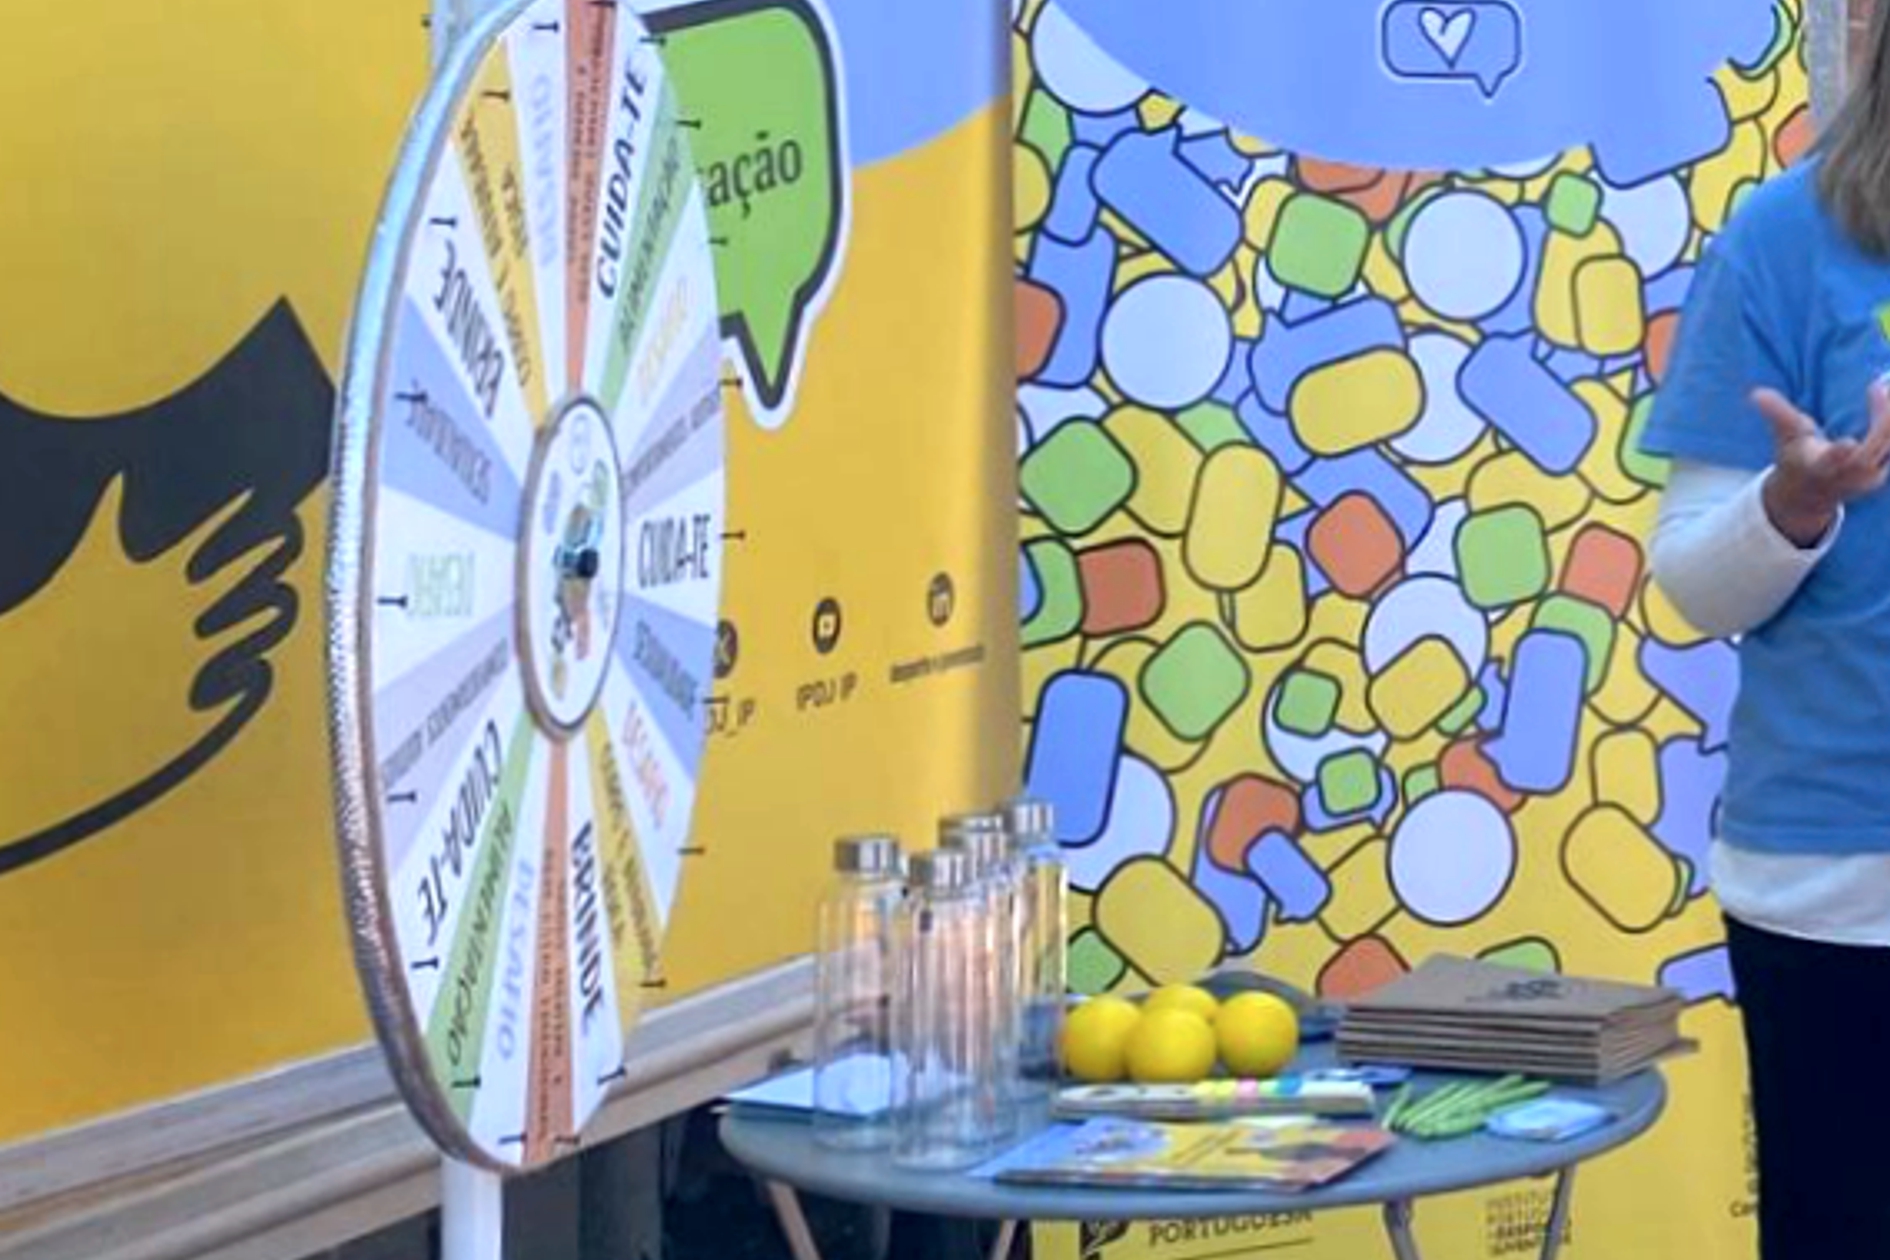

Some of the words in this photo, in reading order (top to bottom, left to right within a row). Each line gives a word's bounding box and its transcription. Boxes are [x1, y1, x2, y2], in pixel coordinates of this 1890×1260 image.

[597, 58, 647, 300] CUIDA-TE
[696, 128, 801, 220] ação
[436, 240, 504, 419] BRINDE
[638, 516, 711, 588] CUIDA-TE
[418, 720, 503, 940] CUIDA-TE
[571, 820, 603, 1028] BRINDE
[447, 804, 514, 1068] ALIMENTAÇÃO
